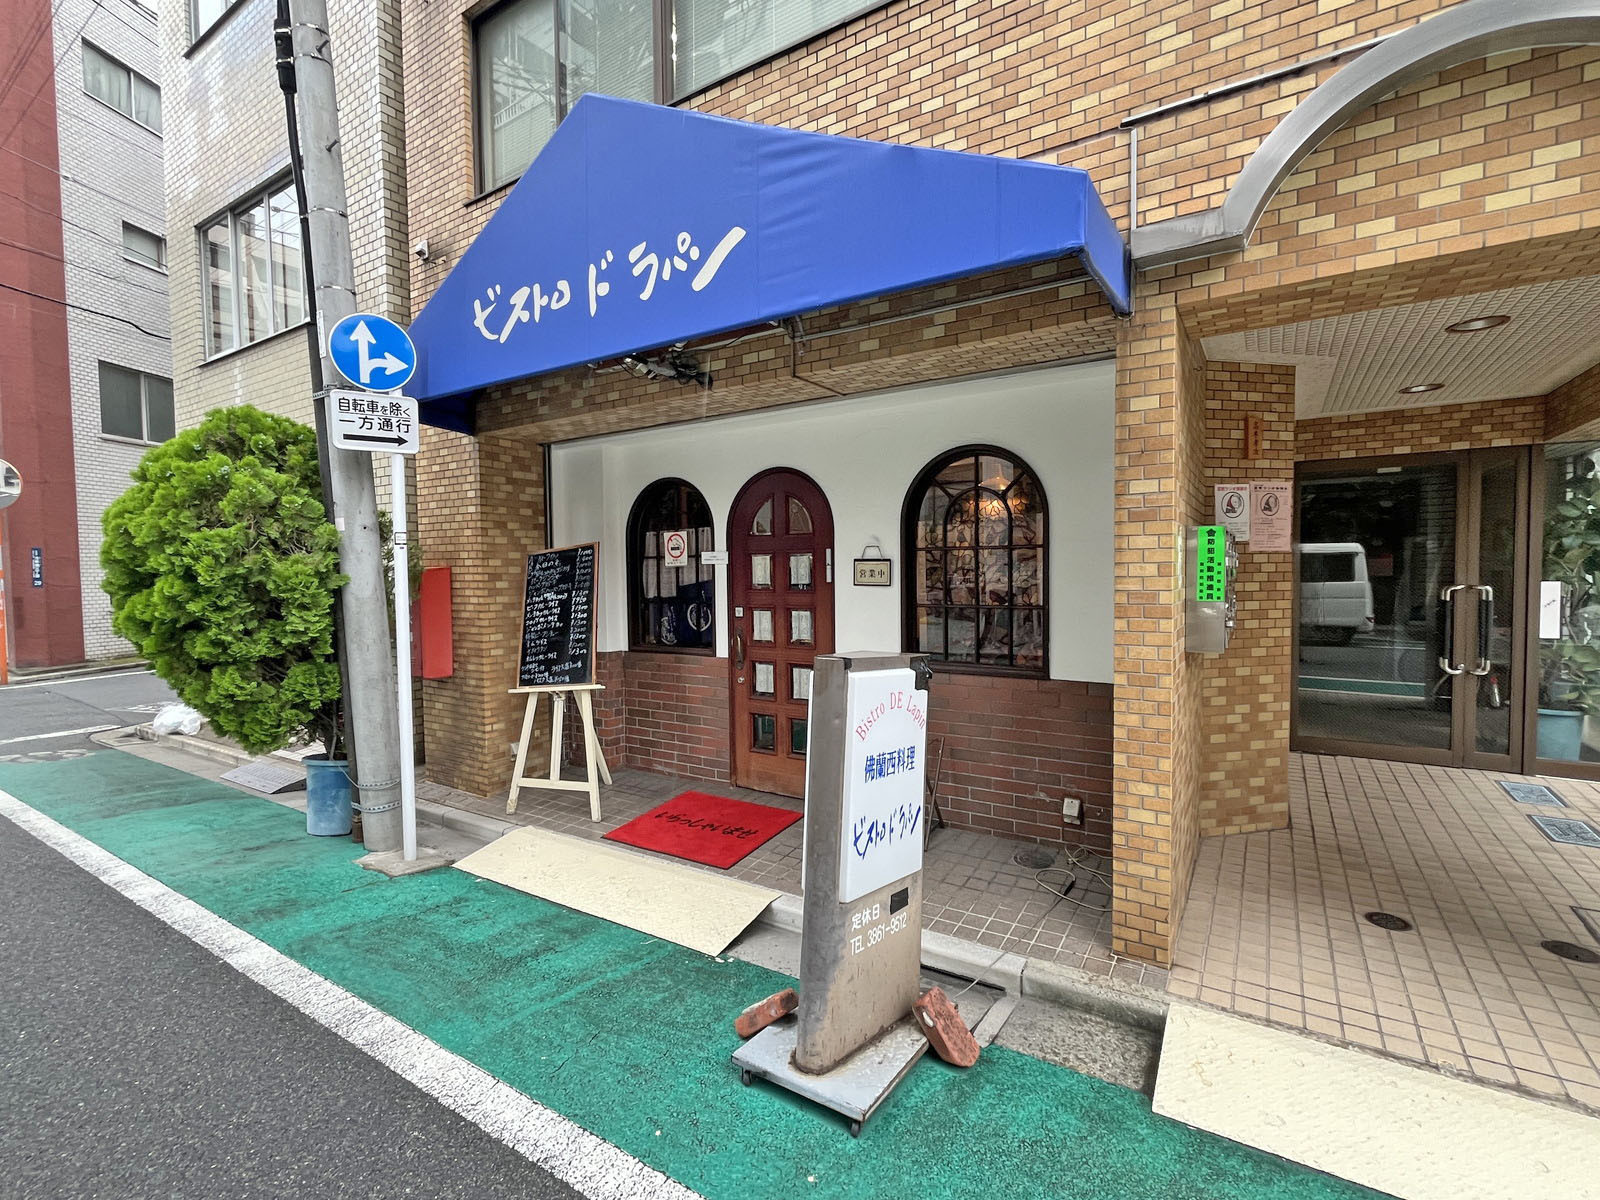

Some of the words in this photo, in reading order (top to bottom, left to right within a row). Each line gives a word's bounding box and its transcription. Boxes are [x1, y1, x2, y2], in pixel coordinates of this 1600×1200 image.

[474, 283, 571, 343] ビストロ
[588, 249, 613, 317] ド
[629, 226, 747, 301] ラパン
[338, 397, 411, 417] 自転車を除く
[338, 416, 412, 433] 一方通行
[859, 568, 886, 579] 営業中
[855, 703, 886, 741] Bistro
[890, 691, 903, 710] DE
[906, 694, 926, 730] Lapin
[864, 745, 915, 784] 佛蘭西料理
[853, 815, 886, 860] ビストロ
[889, 808, 897, 845] ド
[899, 802, 921, 840] ラパン
[851, 903, 880, 932] 定休日
[850, 935, 865, 956] TEL
